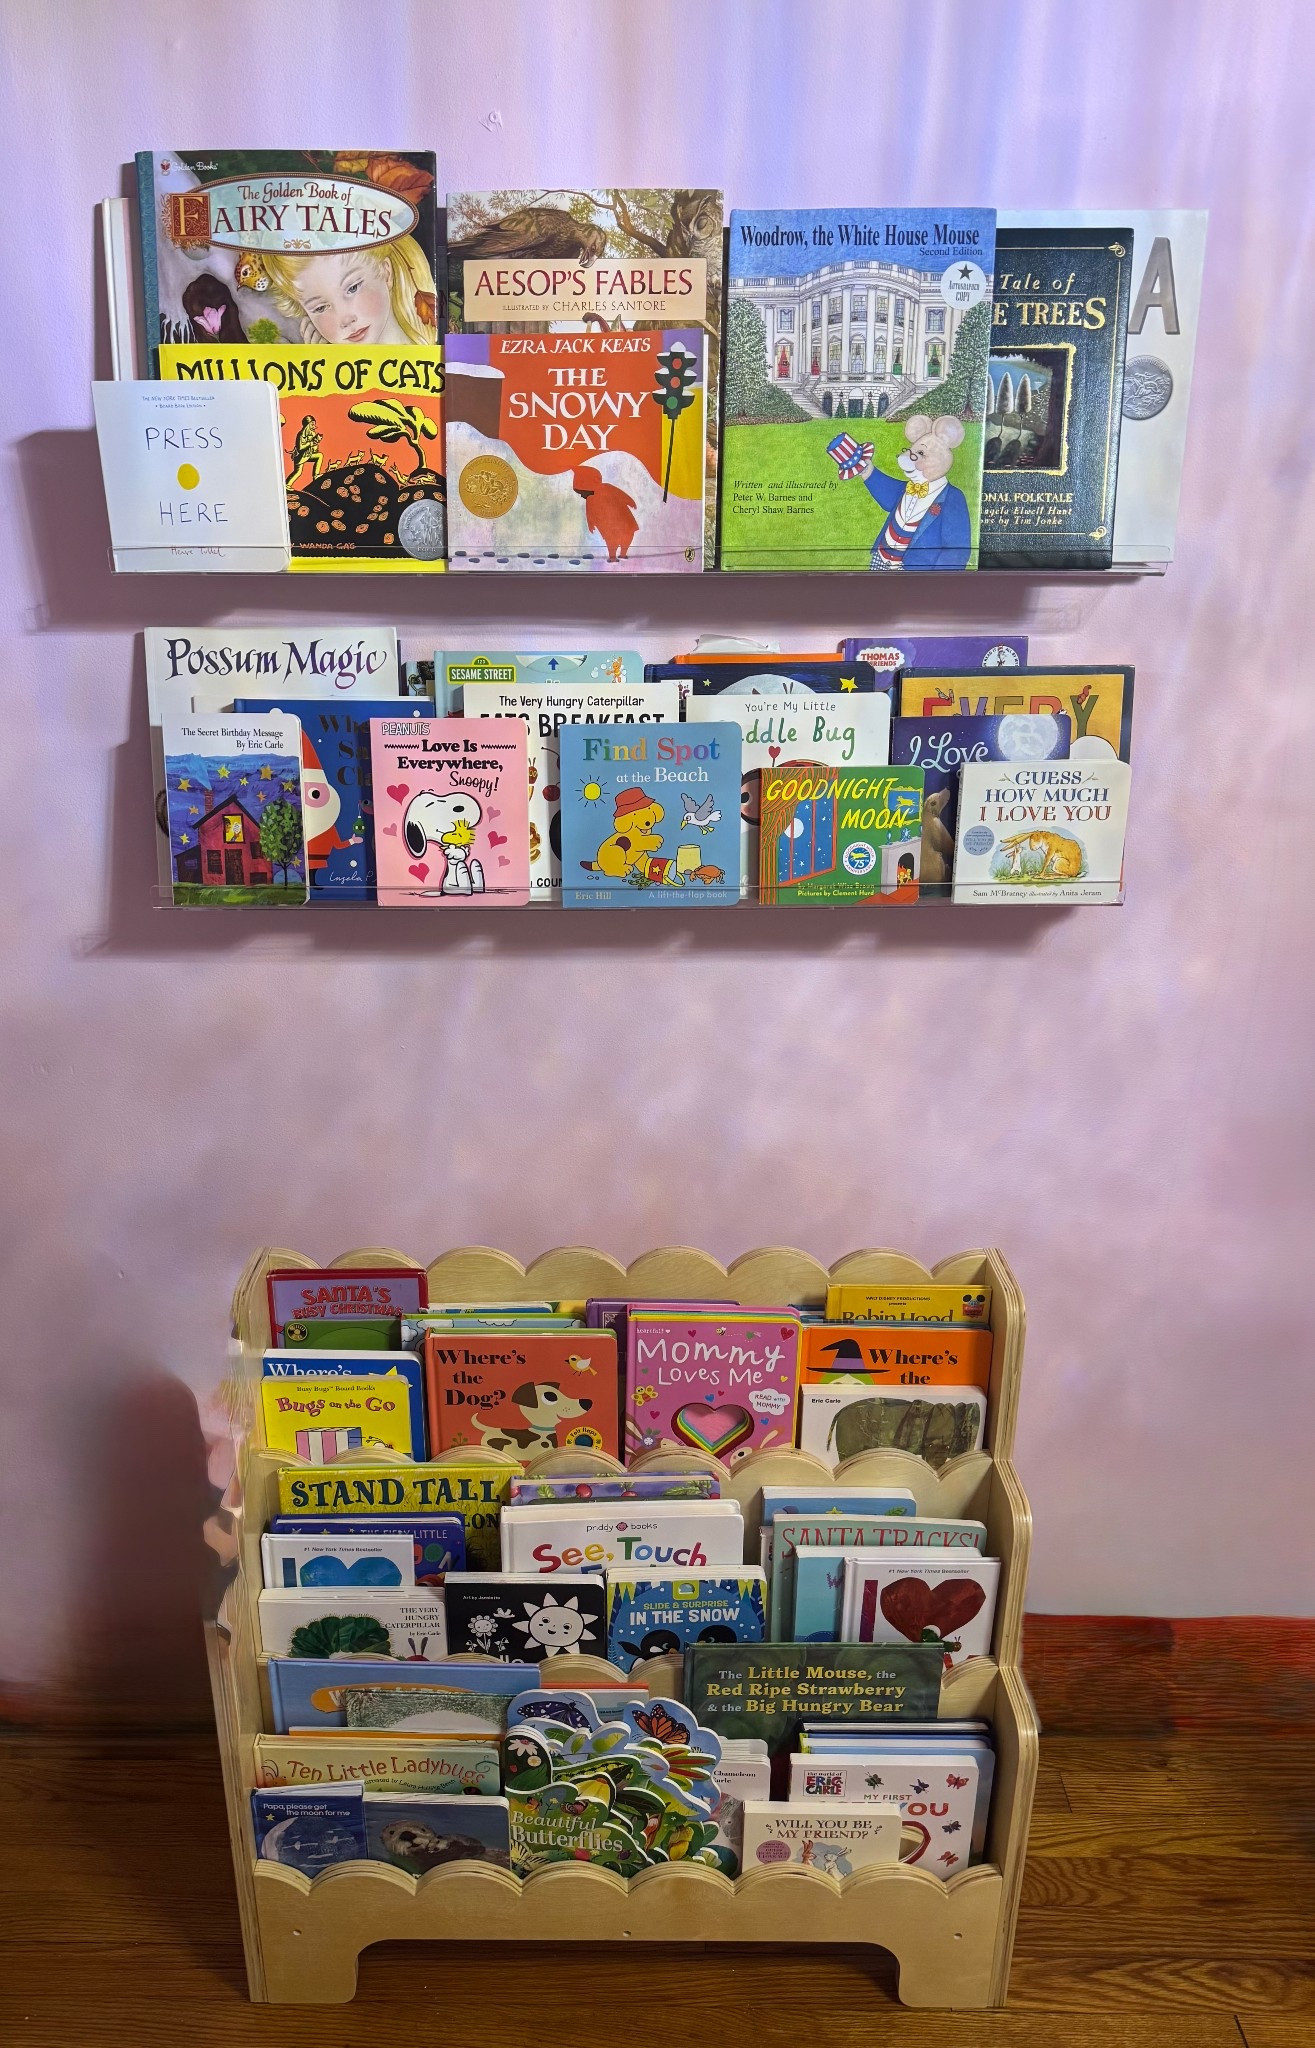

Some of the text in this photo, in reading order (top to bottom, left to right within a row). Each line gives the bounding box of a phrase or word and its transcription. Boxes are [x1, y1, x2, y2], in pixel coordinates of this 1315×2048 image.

[237, 183, 353, 204] The Golden Book of
[176, 196, 392, 238] FAIRY TALES
[741, 223, 979, 249] Woodrow, the White House Mouse
[919, 248, 982, 256] Second Edition
[474, 270, 693, 297] AESOP'S FABLES
[1001, 273, 1042, 290] Tale
[1052, 273, 1076, 295] of
[553, 301, 607, 311] CHARLES
[611, 301, 666, 311] SANTORE
[1018, 298, 1106, 329] TREES
[500, 338, 651, 355] EZRA JACK KEATS
[336, 361, 372, 390] OF
[378, 360, 445, 393] CATS
[548, 368, 607, 386] THE
[508, 391, 651, 419] SNOWY
[146, 427, 223, 450] PRESS
[542, 424, 618, 451] DAY
[734, 480, 838, 491] Written and illustrated by
[733, 493, 812, 501] Peter W. Barnes and
[160, 502, 228, 526] HERE
[732, 506, 814, 516] Cheryl Shaw Barnes
[164, 638, 387, 689] Possum Magic
[451, 668, 512, 680] SESAME STREET
[499, 696, 644, 708] The Very Hungry Caterpillar
[745, 701, 835, 713] You're My Little
[182, 728, 283, 739] The Secret Birthday Message
[382, 722, 430, 735] PEANUTS
[236, 740, 283, 750] By Eric Carle
[422, 740, 477, 752] Love Is
[813, 716, 855, 760] Bug
[582, 737, 720, 765] Find Spot
[397, 757, 503, 772] Everywhere,
[616, 767, 709, 783] at the Beach
[1015, 771, 1082, 785] GUESS
[449, 772, 499, 798] Snoopy!
[767, 778, 899, 801] GOODNIGHT
[985, 788, 1109, 802] HOW MUCH
[841, 808, 910, 830] MOON
[979, 806, 1112, 822] I LOVE YOU
[576, 891, 611, 900] Eric Hill
[657, 891, 704, 899] lift-the-flap
[707, 891, 727, 899] book
[301, 1286, 391, 1305] SANTA'S
[292, 1303, 403, 1319] BUSY CHRISTMAS
[437, 1350, 526, 1365] Where's
[637, 1339, 785, 1372] Mommy
[453, 1371, 483, 1384] the
[658, 1367, 762, 1386] Loves Me
[275, 1397, 325, 1417] Bugs
[345, 1399, 361, 1409] the
[365, 1397, 395, 1412] Go
[445, 1389, 506, 1410] Dog?
[756, 1401, 780, 1409] MOMMY
[290, 1479, 405, 1507] STAND
[586, 1522, 658, 1533] priddy books
[532, 1536, 707, 1573] See, Touch
[630, 1608, 740, 1626] IN THE SNOW
[719, 1667, 896, 1681] The Little Mouse, the
[707, 1683, 906, 1698] Red Ripe Strawberry
[707, 1700, 903, 1714] & the Big Hungry Bear
[287, 1761, 322, 1781] Ten
[327, 1761, 386, 1782] Little
[391, 1757, 485, 1785] Ladybugs
[263, 1804, 285, 1812] Papa,
[286, 1804, 312, 1812] please
[511, 1811, 597, 1830] Beautiful
[776, 1820, 872, 1829] WILL YOU BE
[512, 1825, 623, 1852] Butterflies
[778, 1830, 868, 1839] MY FRIEND?
